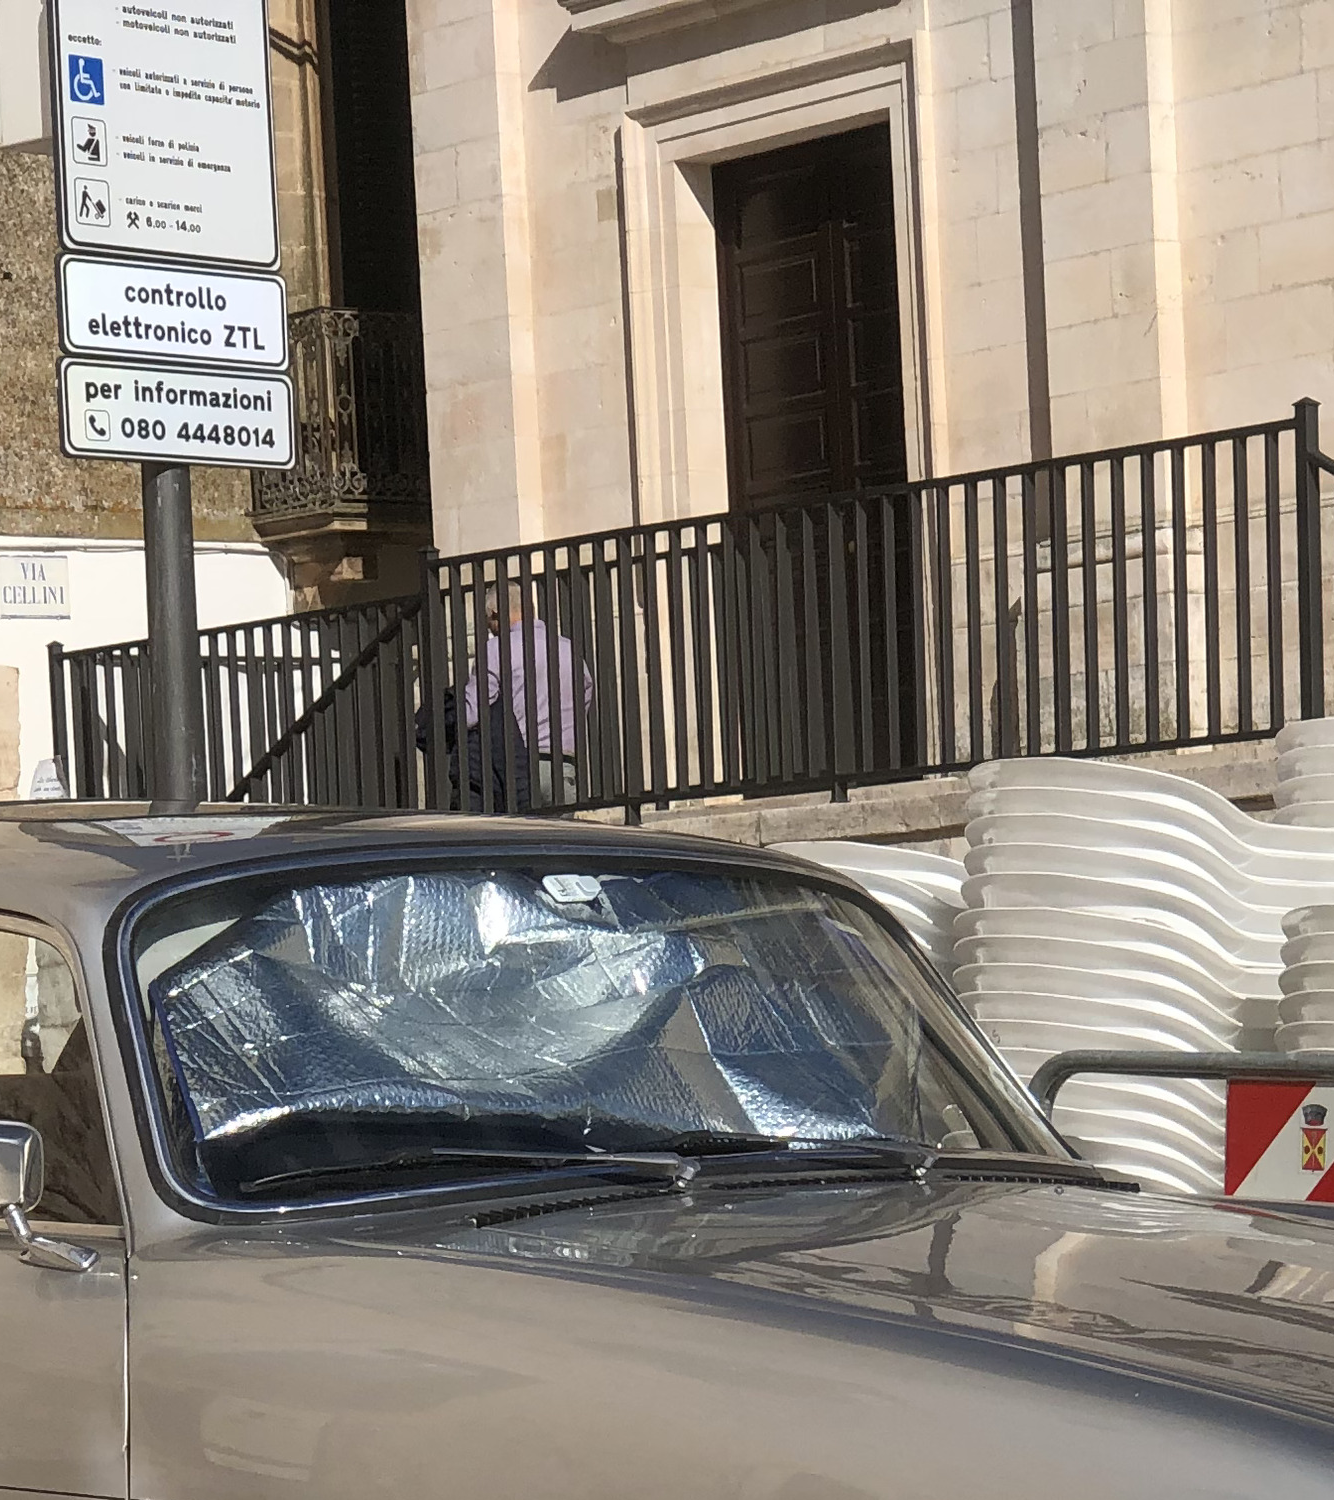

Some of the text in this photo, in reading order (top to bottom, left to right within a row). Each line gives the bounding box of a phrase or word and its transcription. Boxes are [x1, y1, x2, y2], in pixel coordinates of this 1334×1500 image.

[122, 5, 234, 30] autoveicoli non autorizzati
[122, 19, 236, 44] motoveicoli non autorizzati
[168, 139, 175, 149] di
[187, 158, 194, 168] di
[175, 219, 202, 234] 14.00
[124, 283, 227, 311] controllo
[88, 313, 266, 350] elettronico ZTL
[85, 379, 272, 412] per informazioni
[120, 417, 275, 449] 080 4448014
[21, 562, 46, 581] VIA
[3, 586, 65, 605] CELLINI
